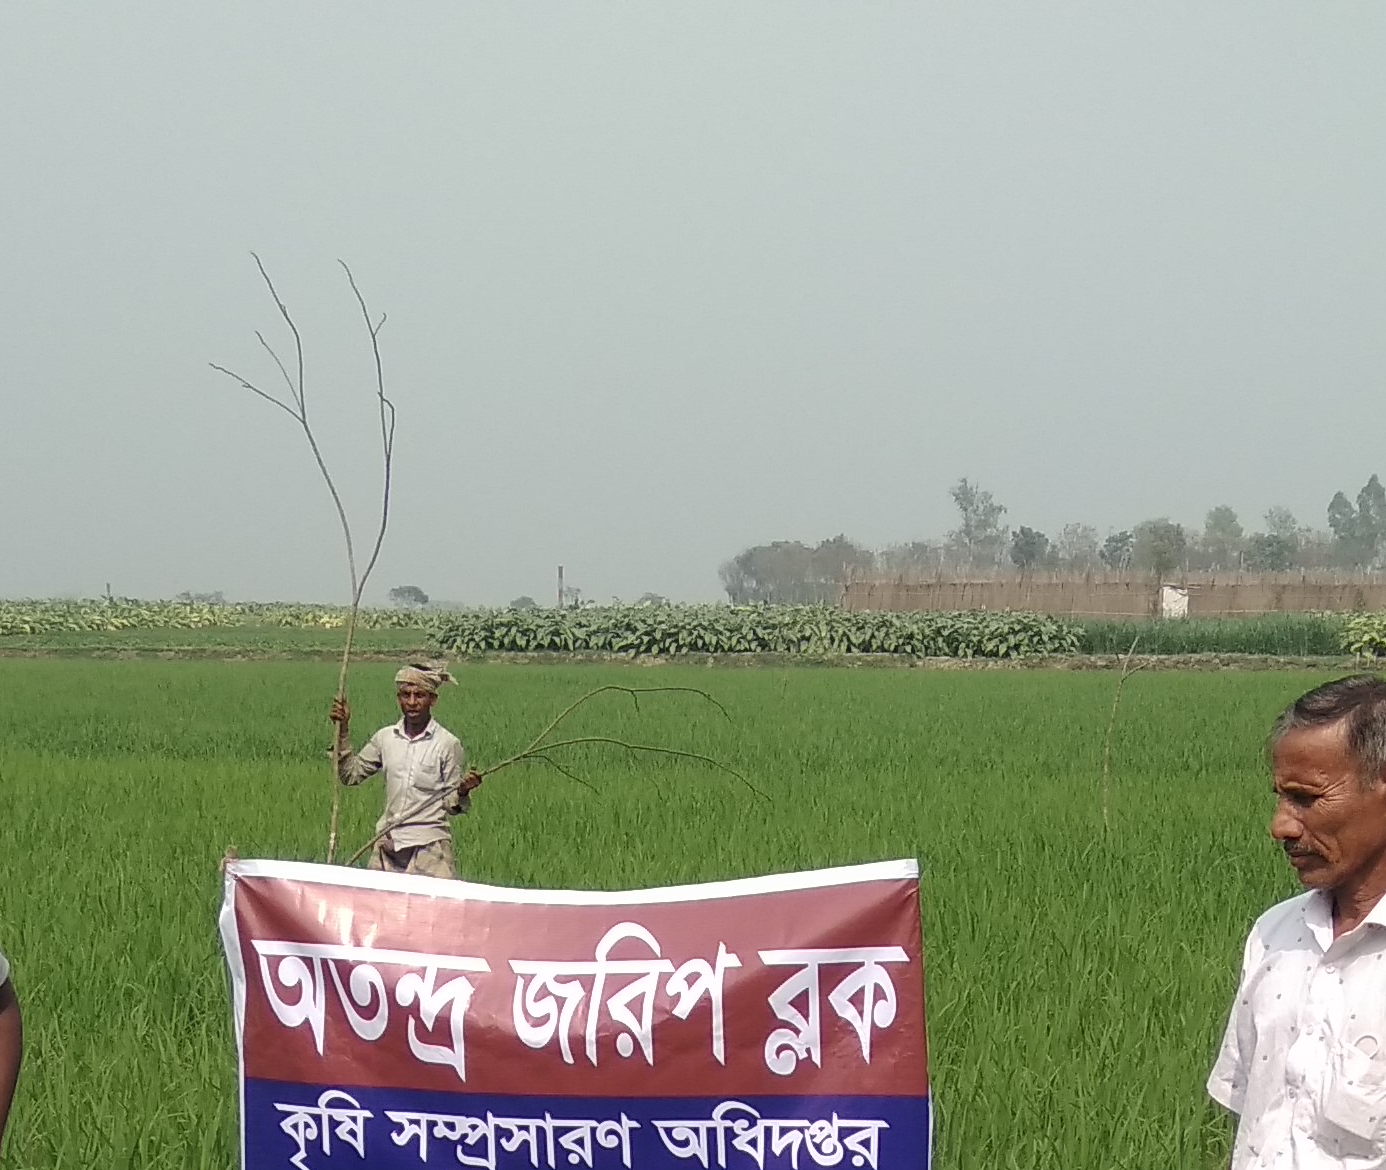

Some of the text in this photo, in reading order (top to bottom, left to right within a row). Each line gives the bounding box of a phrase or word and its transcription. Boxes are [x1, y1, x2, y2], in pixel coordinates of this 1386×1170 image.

[251, 921, 910, 1083] অতন্দ্র জরিপ ব্লক
[652, 1101, 889, 1170] অধিদপ্তর
